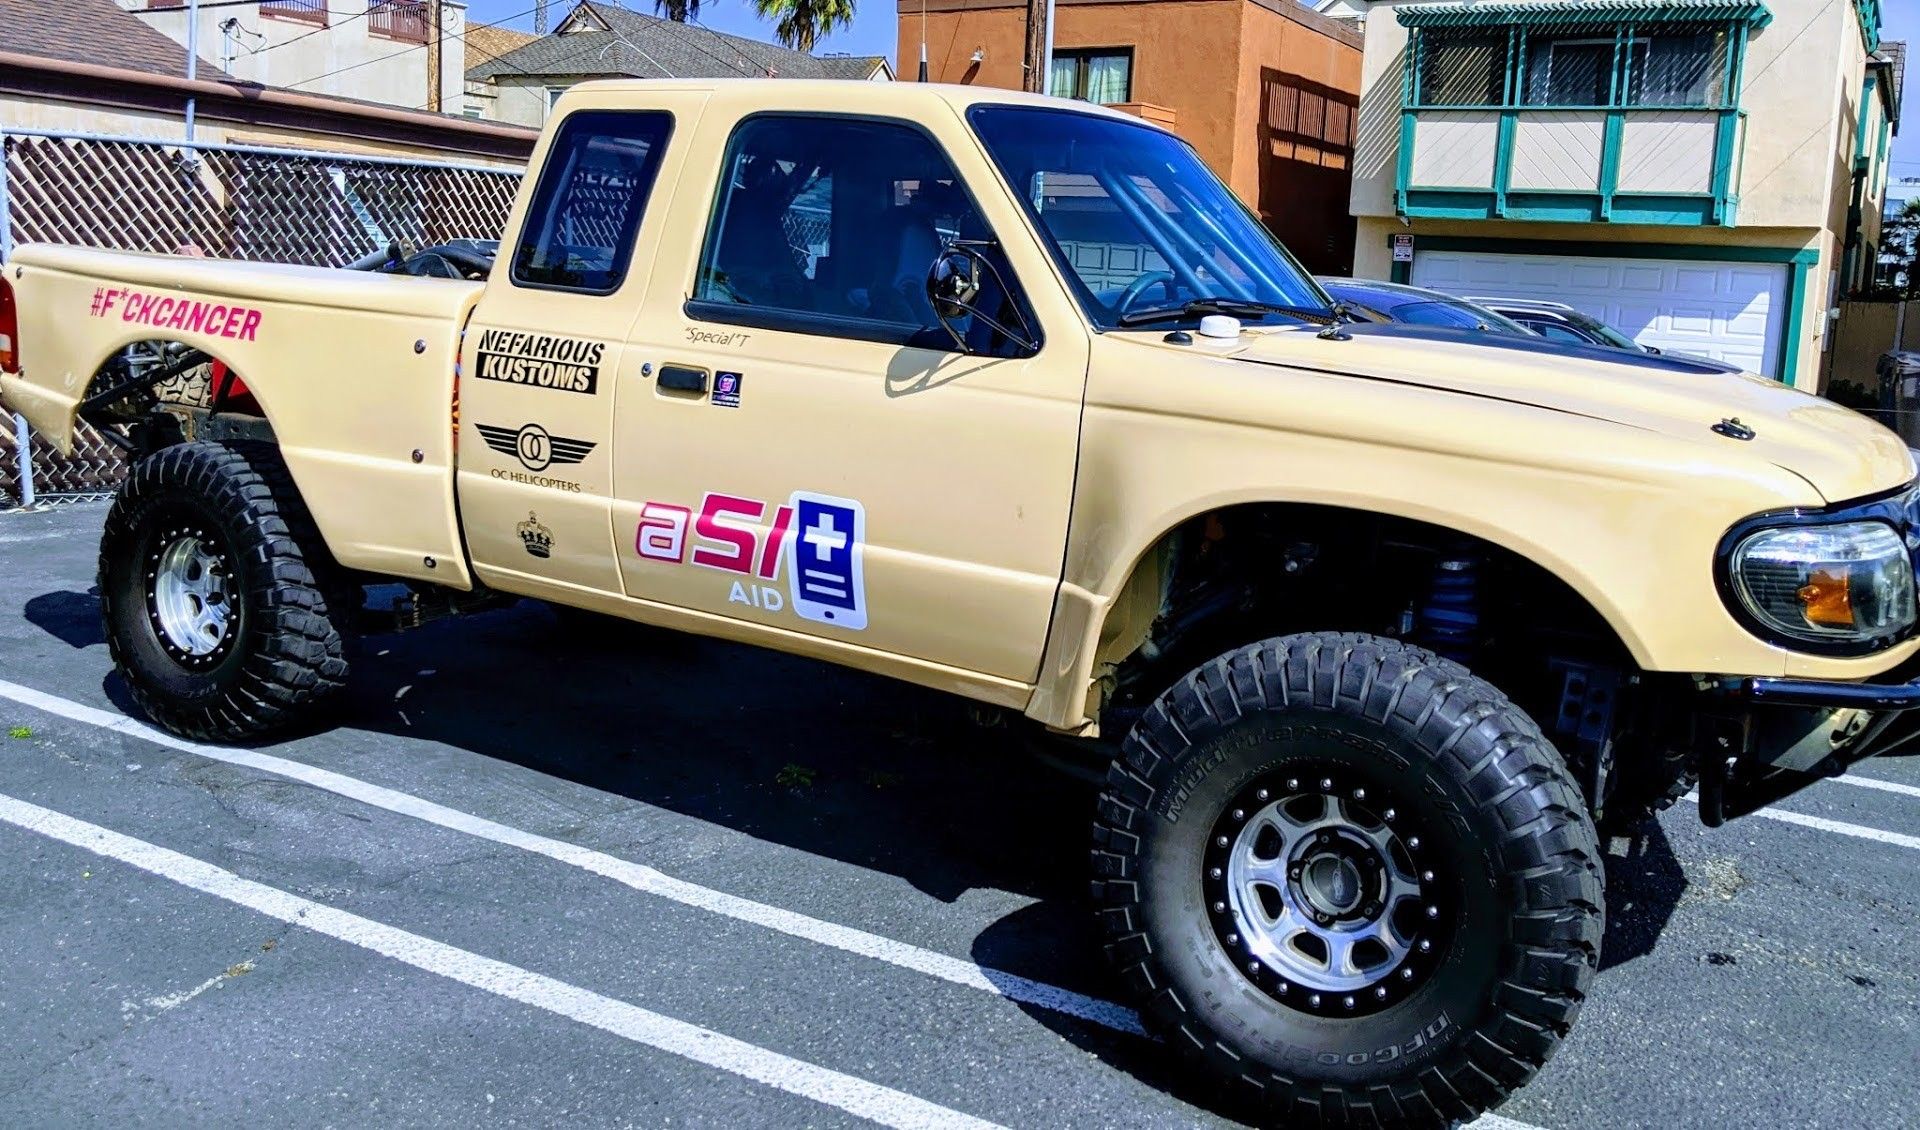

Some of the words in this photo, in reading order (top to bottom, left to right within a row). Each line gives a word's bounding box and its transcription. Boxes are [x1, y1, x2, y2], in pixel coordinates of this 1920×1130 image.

[478, 329, 606, 365] NEFARIOUS
[482, 354, 592, 391] KUSTOMS
[491, 468, 508, 479] OC
[510, 471, 581, 493] HELICOPTERS
[728, 580, 784, 612] AID
